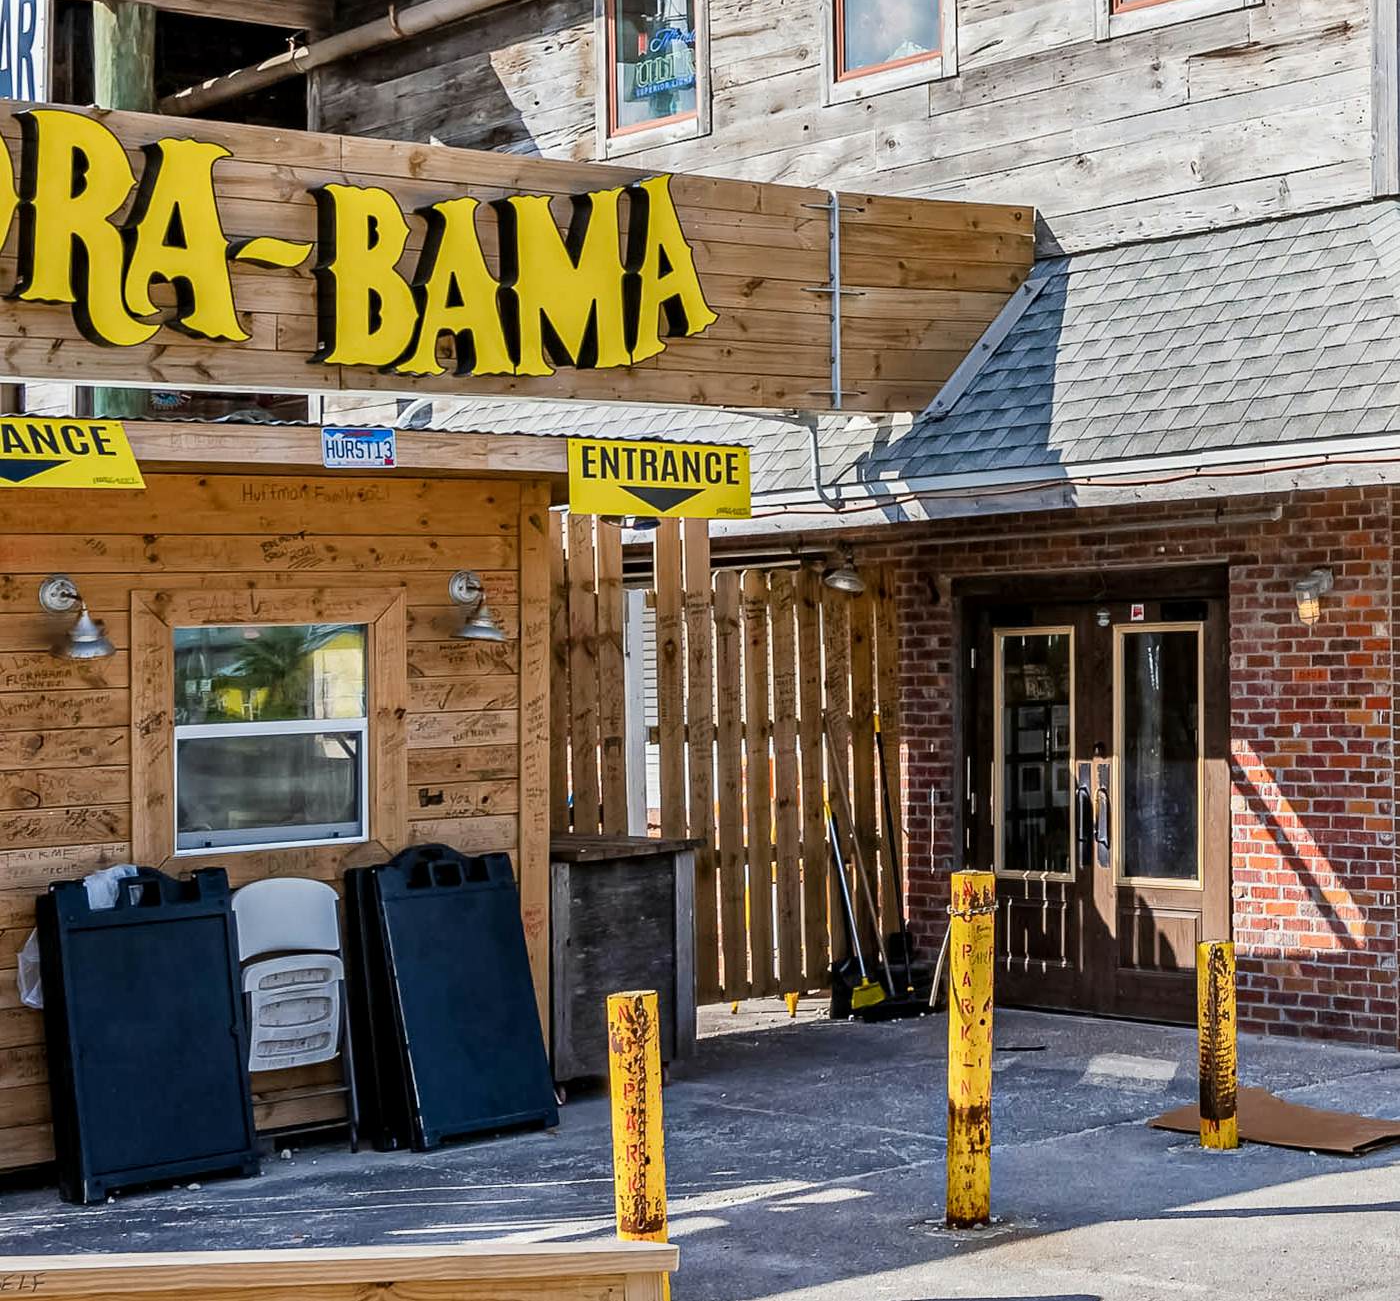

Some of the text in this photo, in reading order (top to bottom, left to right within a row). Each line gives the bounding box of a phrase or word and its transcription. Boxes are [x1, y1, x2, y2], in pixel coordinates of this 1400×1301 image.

[0, 108, 720, 378] RA-BAMA
[0, 423, 117, 457] ANCE
[325, 439, 393, 460] HURST13
[581, 445, 741, 485] ENTRANCE
[0, 1271, 47, 1293] ELF
